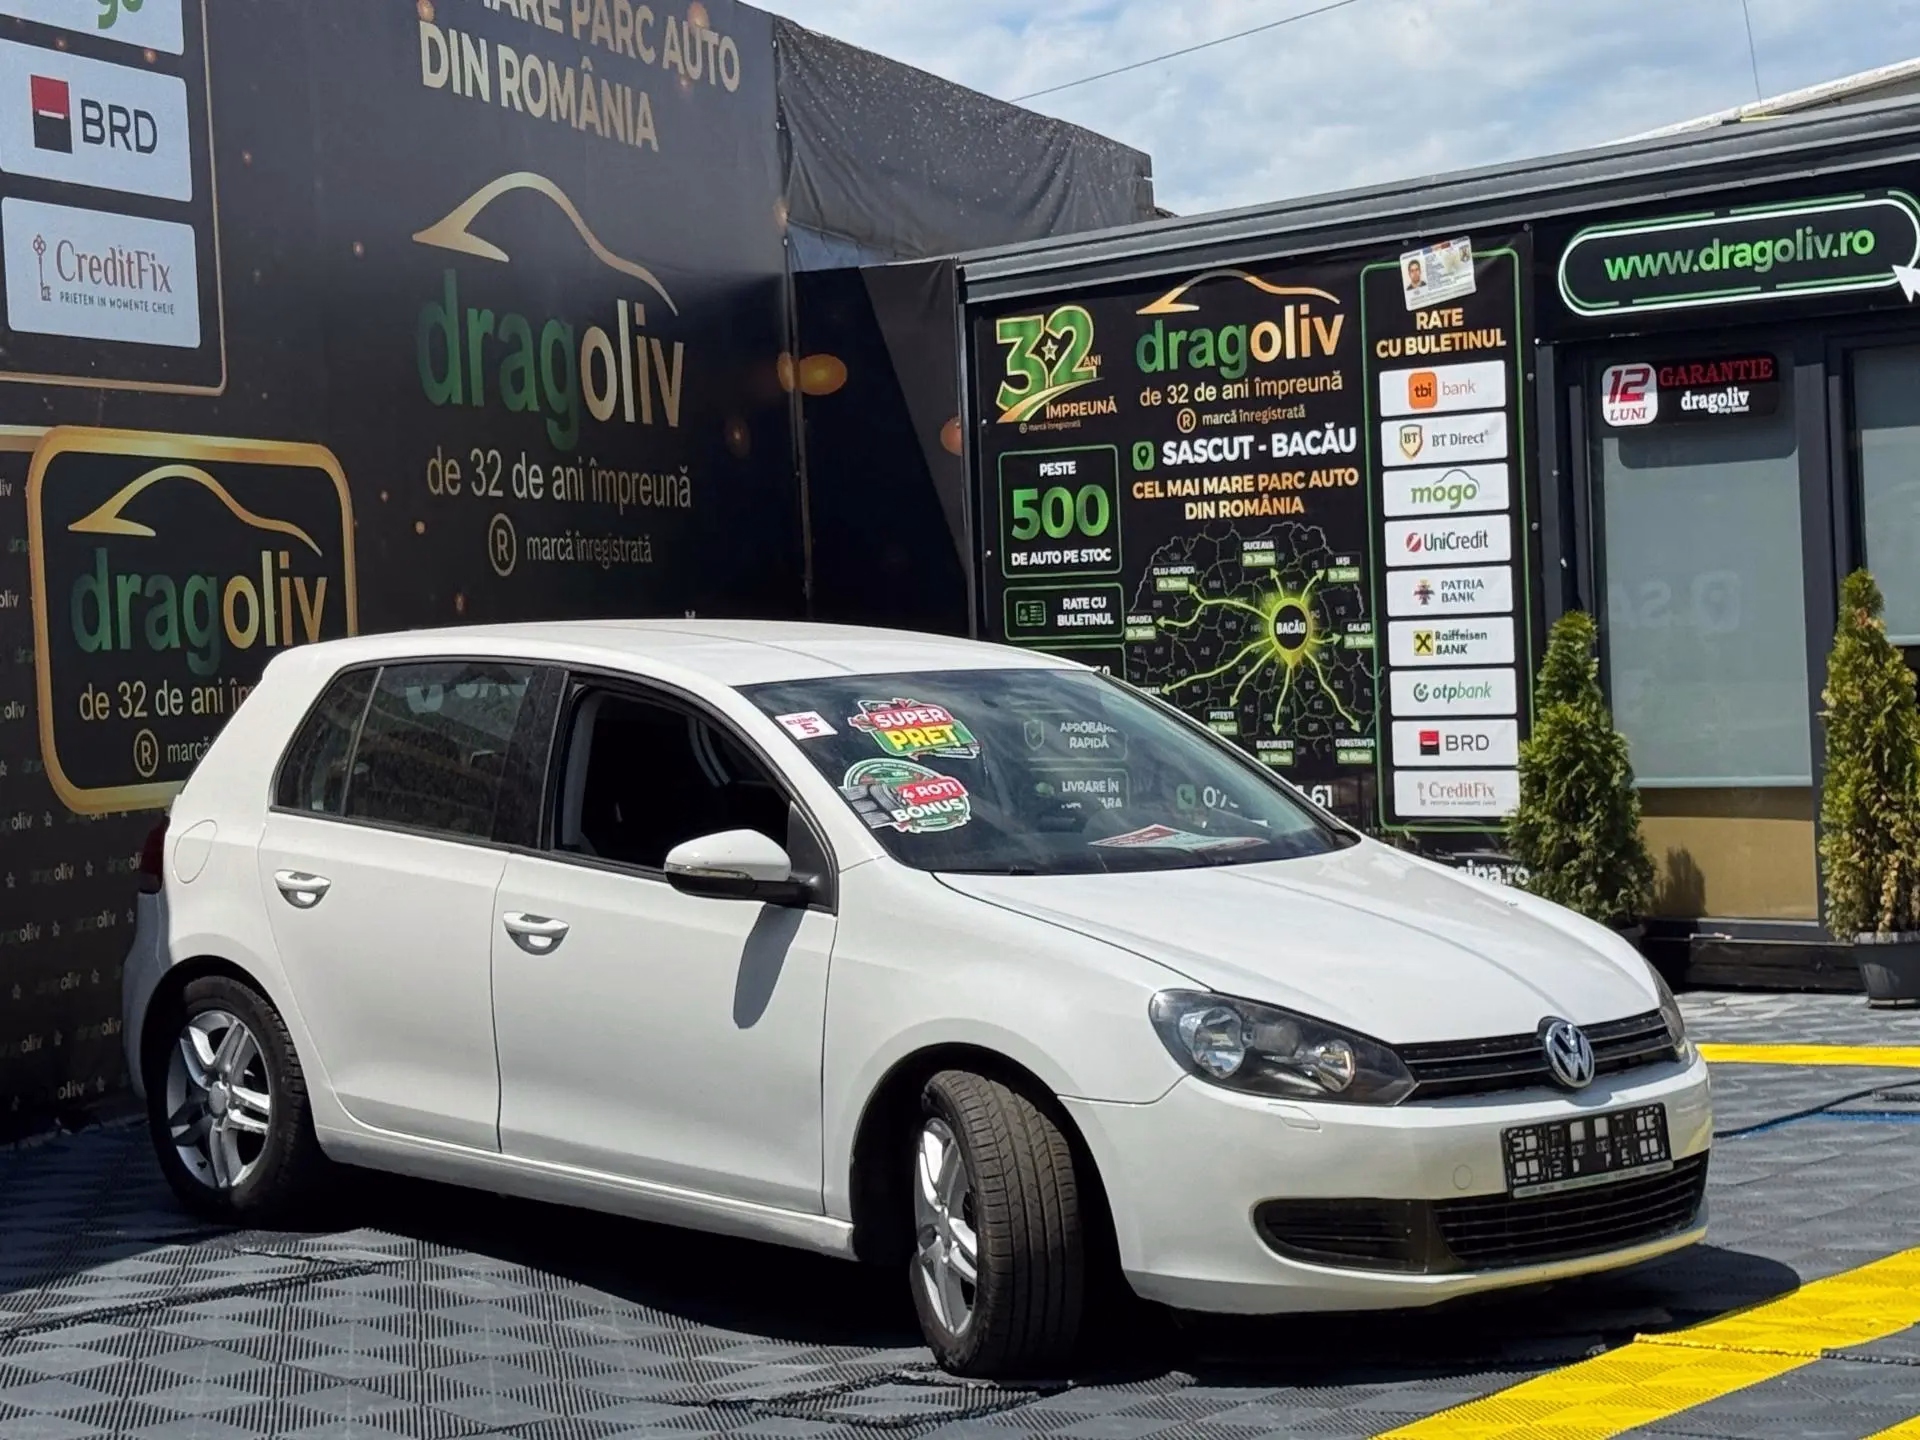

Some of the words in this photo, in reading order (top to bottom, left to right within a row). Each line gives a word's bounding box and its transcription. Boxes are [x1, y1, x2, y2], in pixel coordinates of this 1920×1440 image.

[571, 0, 656, 65] PARC
[663, 15, 741, 93] AUTO
[419, 21, 490, 102] DIN
[498, 45, 660, 152] ROMÂNIA
[80, 98, 158, 154] BRD
[1603, 226, 1876, 282] www.dragoliv.ro
[56, 239, 173, 293] CreditFix
[60, 291, 95, 306] PRIETEN
[97, 296, 107, 308] IN
[109, 298, 149, 313] MOMENTE
[151, 302, 175, 315] CHEIE
[1415, 307, 1465, 330] RATE
[1136, 304, 1345, 379] dragoliv
[1376, 337, 1402, 358] CU
[1405, 328, 1507, 356] BULETINUL
[417, 269, 684, 451] dragoliv
[996, 305, 1095, 412] 32
[1083, 355, 1102, 367] ANI
[1659, 358, 1773, 387] GARANTIE
[1140, 386, 1162, 406] de
[1167, 383, 1189, 405] 32
[1194, 381, 1217, 402] de
[1222, 378, 1249, 400] ani
[1255, 370, 1343, 400] împreună
[1414, 382, 1432, 398] tbi
[1442, 379, 1477, 396] bank
[1608, 368, 1650, 405] 12
[1046, 396, 1118, 419] ÎMPREUNĂ
[1680, 386, 1750, 414] dragoliv
[1202, 409, 1237, 426] marcă
[1239, 404, 1306, 426] înregistrată
[1609, 407, 1647, 422] LUNI
[1162, 435, 1255, 466] SASCUT
[1271, 422, 1357, 458] BACĂU
[1404, 432, 1418, 444] BT
[1432, 434, 1448, 447] BT
[427, 446, 461, 495] de
[470, 448, 504, 497] 32
[512, 452, 544, 499] de
[552, 456, 585, 501] ani
[591, 457, 692, 515] împreună
[1039, 461, 1076, 477] PESTE
[1132, 481, 1164, 499] CEL
[1167, 479, 1200, 498] MAI
[1203, 475, 1255, 495] MARE
[1258, 472, 1306, 492] PARC
[1308, 468, 1360, 489] AUTO
[1185, 501, 1217, 520] DIN
[1219, 494, 1305, 519] ROMÂNIA
[1411, 483, 1477, 510] mogo
[1011, 484, 1110, 541] 500
[527, 530, 574, 561] marcă
[576, 530, 652, 570] înregistrată
[1243, 540, 1275, 550] SUCEAVA
[1424, 530, 1489, 551] UniCredit
[1011, 552, 1028, 567] DE
[1029, 550, 1061, 565] AUTO
[1064, 549, 1079, 564] PE
[1081, 548, 1112, 563] STOC
[1441, 579, 1484, 590] PATRIA
[1063, 597, 1089, 610] RATE
[1091, 596, 1107, 609] CU
[1441, 592, 1476, 603] BANK
[70, 547, 328, 675] dragoliv
[1057, 613, 1114, 627] BULETINUL
[1276, 619, 1306, 634] BACĂU
[1435, 628, 1487, 641] Raiffeisen
[1436, 644, 1468, 655] BANK
[79, 683, 110, 720] de
[118, 681, 148, 718] 32
[155, 680, 183, 716] de
[191, 678, 224, 714] ani
[1433, 681, 1492, 704] otpbank
[801, 723, 820, 734] 5
[875, 708, 947, 728] SUPER
[1069, 734, 1110, 748] RAPIDĂ
[1445, 734, 1490, 751] BRD
[903, 788, 915, 799] 4
[1062, 781, 1106, 793] LIVRARE
[1107, 777, 1119, 793] ÎN
[1311, 784, 1333, 808] 61
[1429, 781, 1496, 799] CreditFix
[892, 798, 965, 822] BONUS
